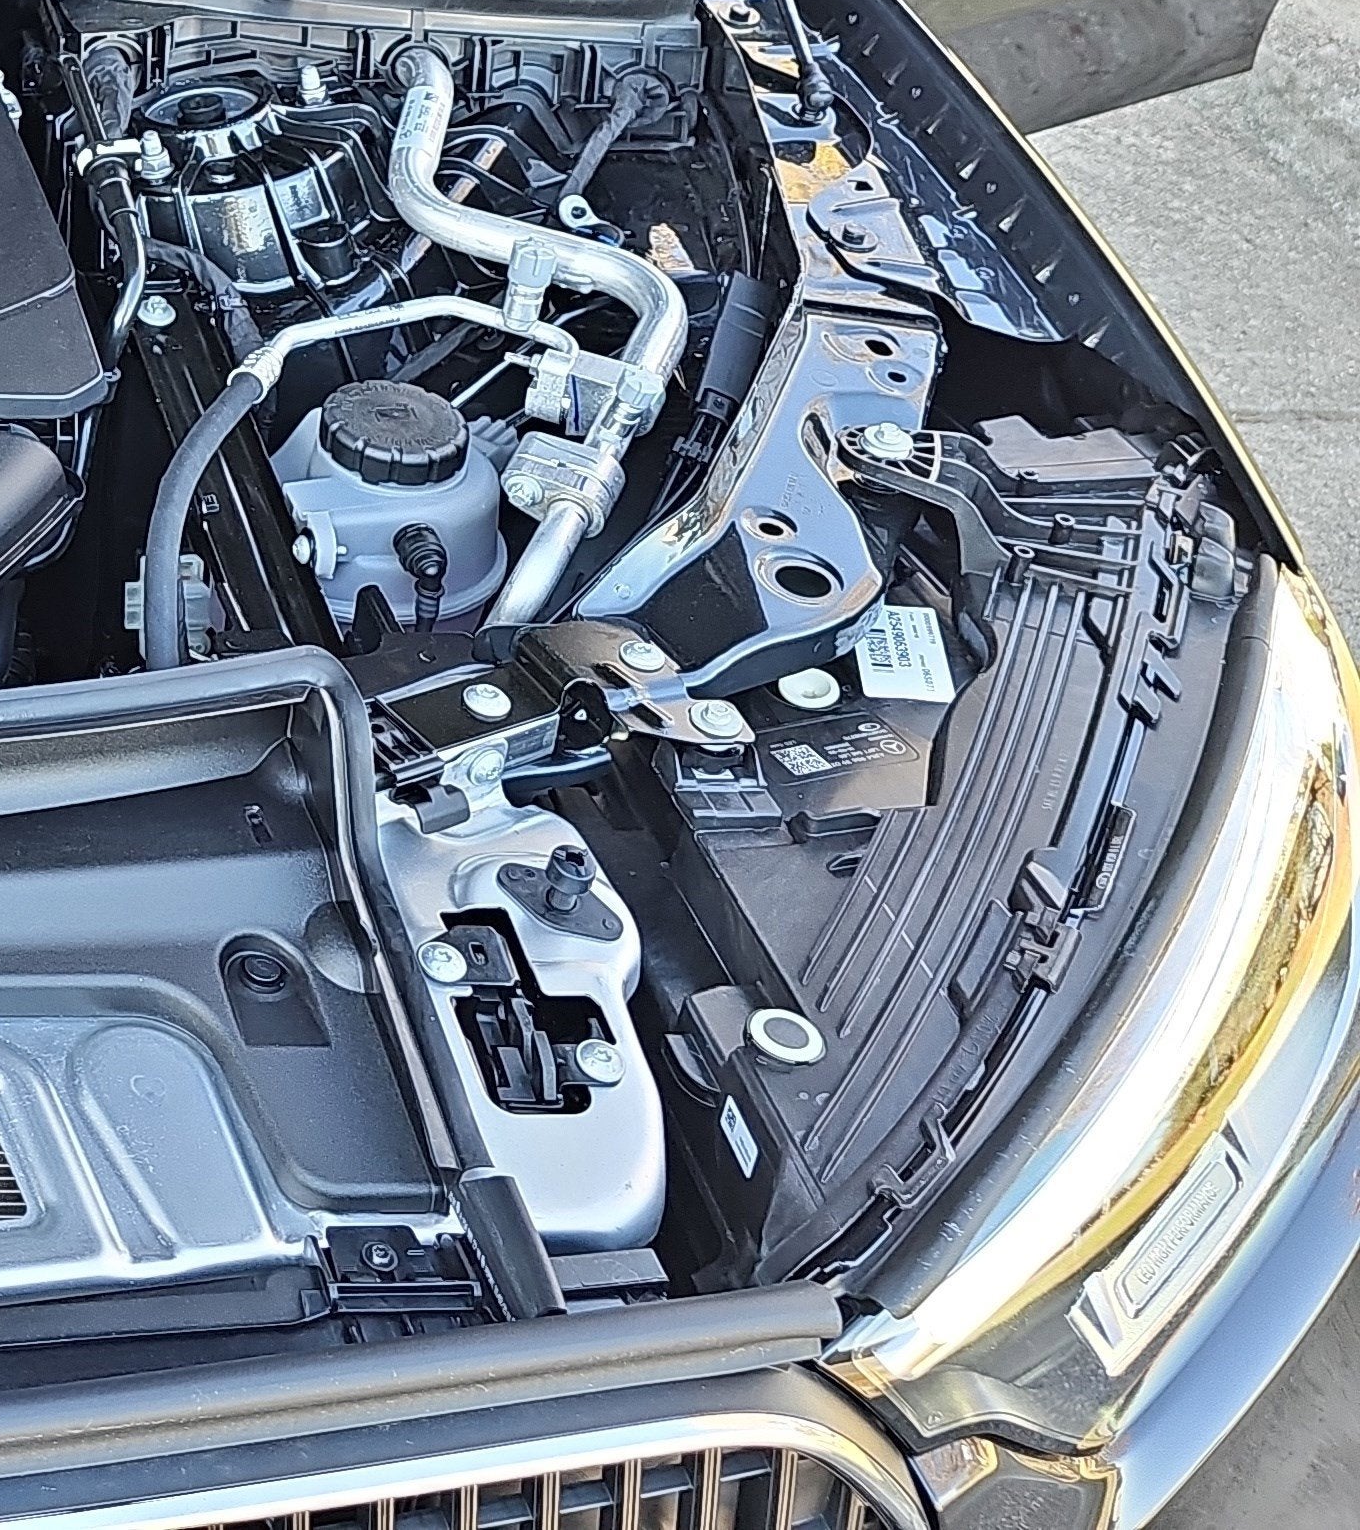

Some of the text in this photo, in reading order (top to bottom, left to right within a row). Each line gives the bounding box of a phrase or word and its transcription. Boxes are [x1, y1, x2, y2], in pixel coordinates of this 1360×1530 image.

[1134, 1179, 1223, 1285] LED HIGH PERFORMANCE
